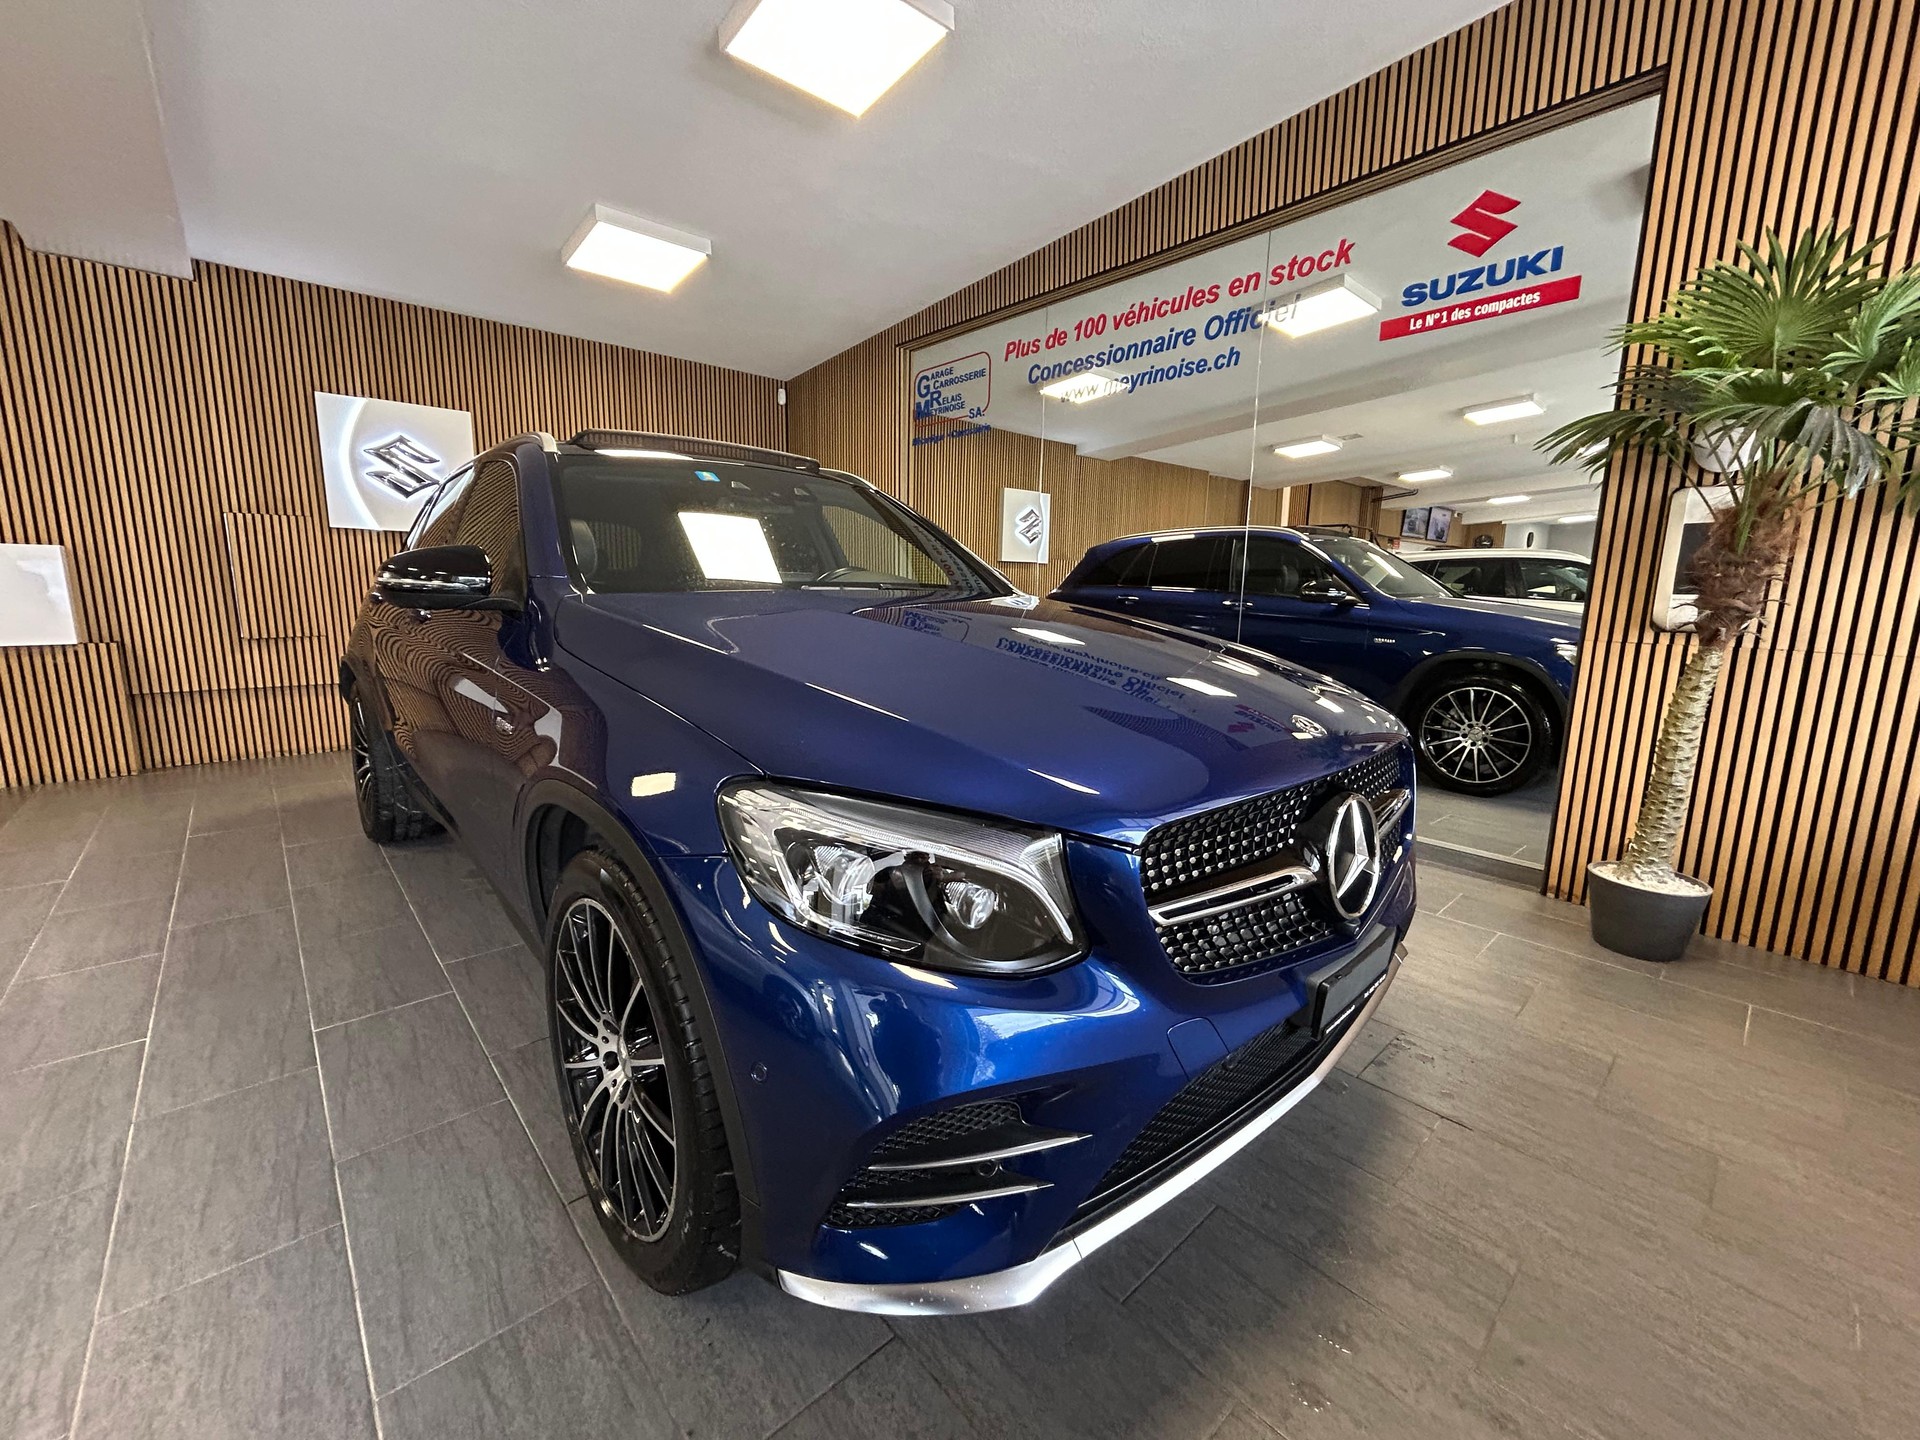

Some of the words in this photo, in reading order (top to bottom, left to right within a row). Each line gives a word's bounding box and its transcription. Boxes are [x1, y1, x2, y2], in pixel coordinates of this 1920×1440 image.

[1005, 339, 1041, 361] Plus
[1045, 328, 1068, 349] de
[1074, 313, 1107, 341] 100
[1113, 284, 1221, 331] véhicules
[1228, 272, 1261, 297] en
[1269, 238, 1356, 286] stock
[1401, 245, 1564, 307] SUZUKI
[1028, 327, 1196, 385] Concessionnaire
[1204, 293, 1301, 340] Officiel
[1409, 317, 1423, 331] Le
[1425, 311, 1448, 328] N°1
[1451, 306, 1471, 321] des
[1474, 291, 1541, 317] compactes
[933, 368, 987, 390] CARROSSERIE
[1061, 346, 1240, 402] wwwmeyrinoise.ch
